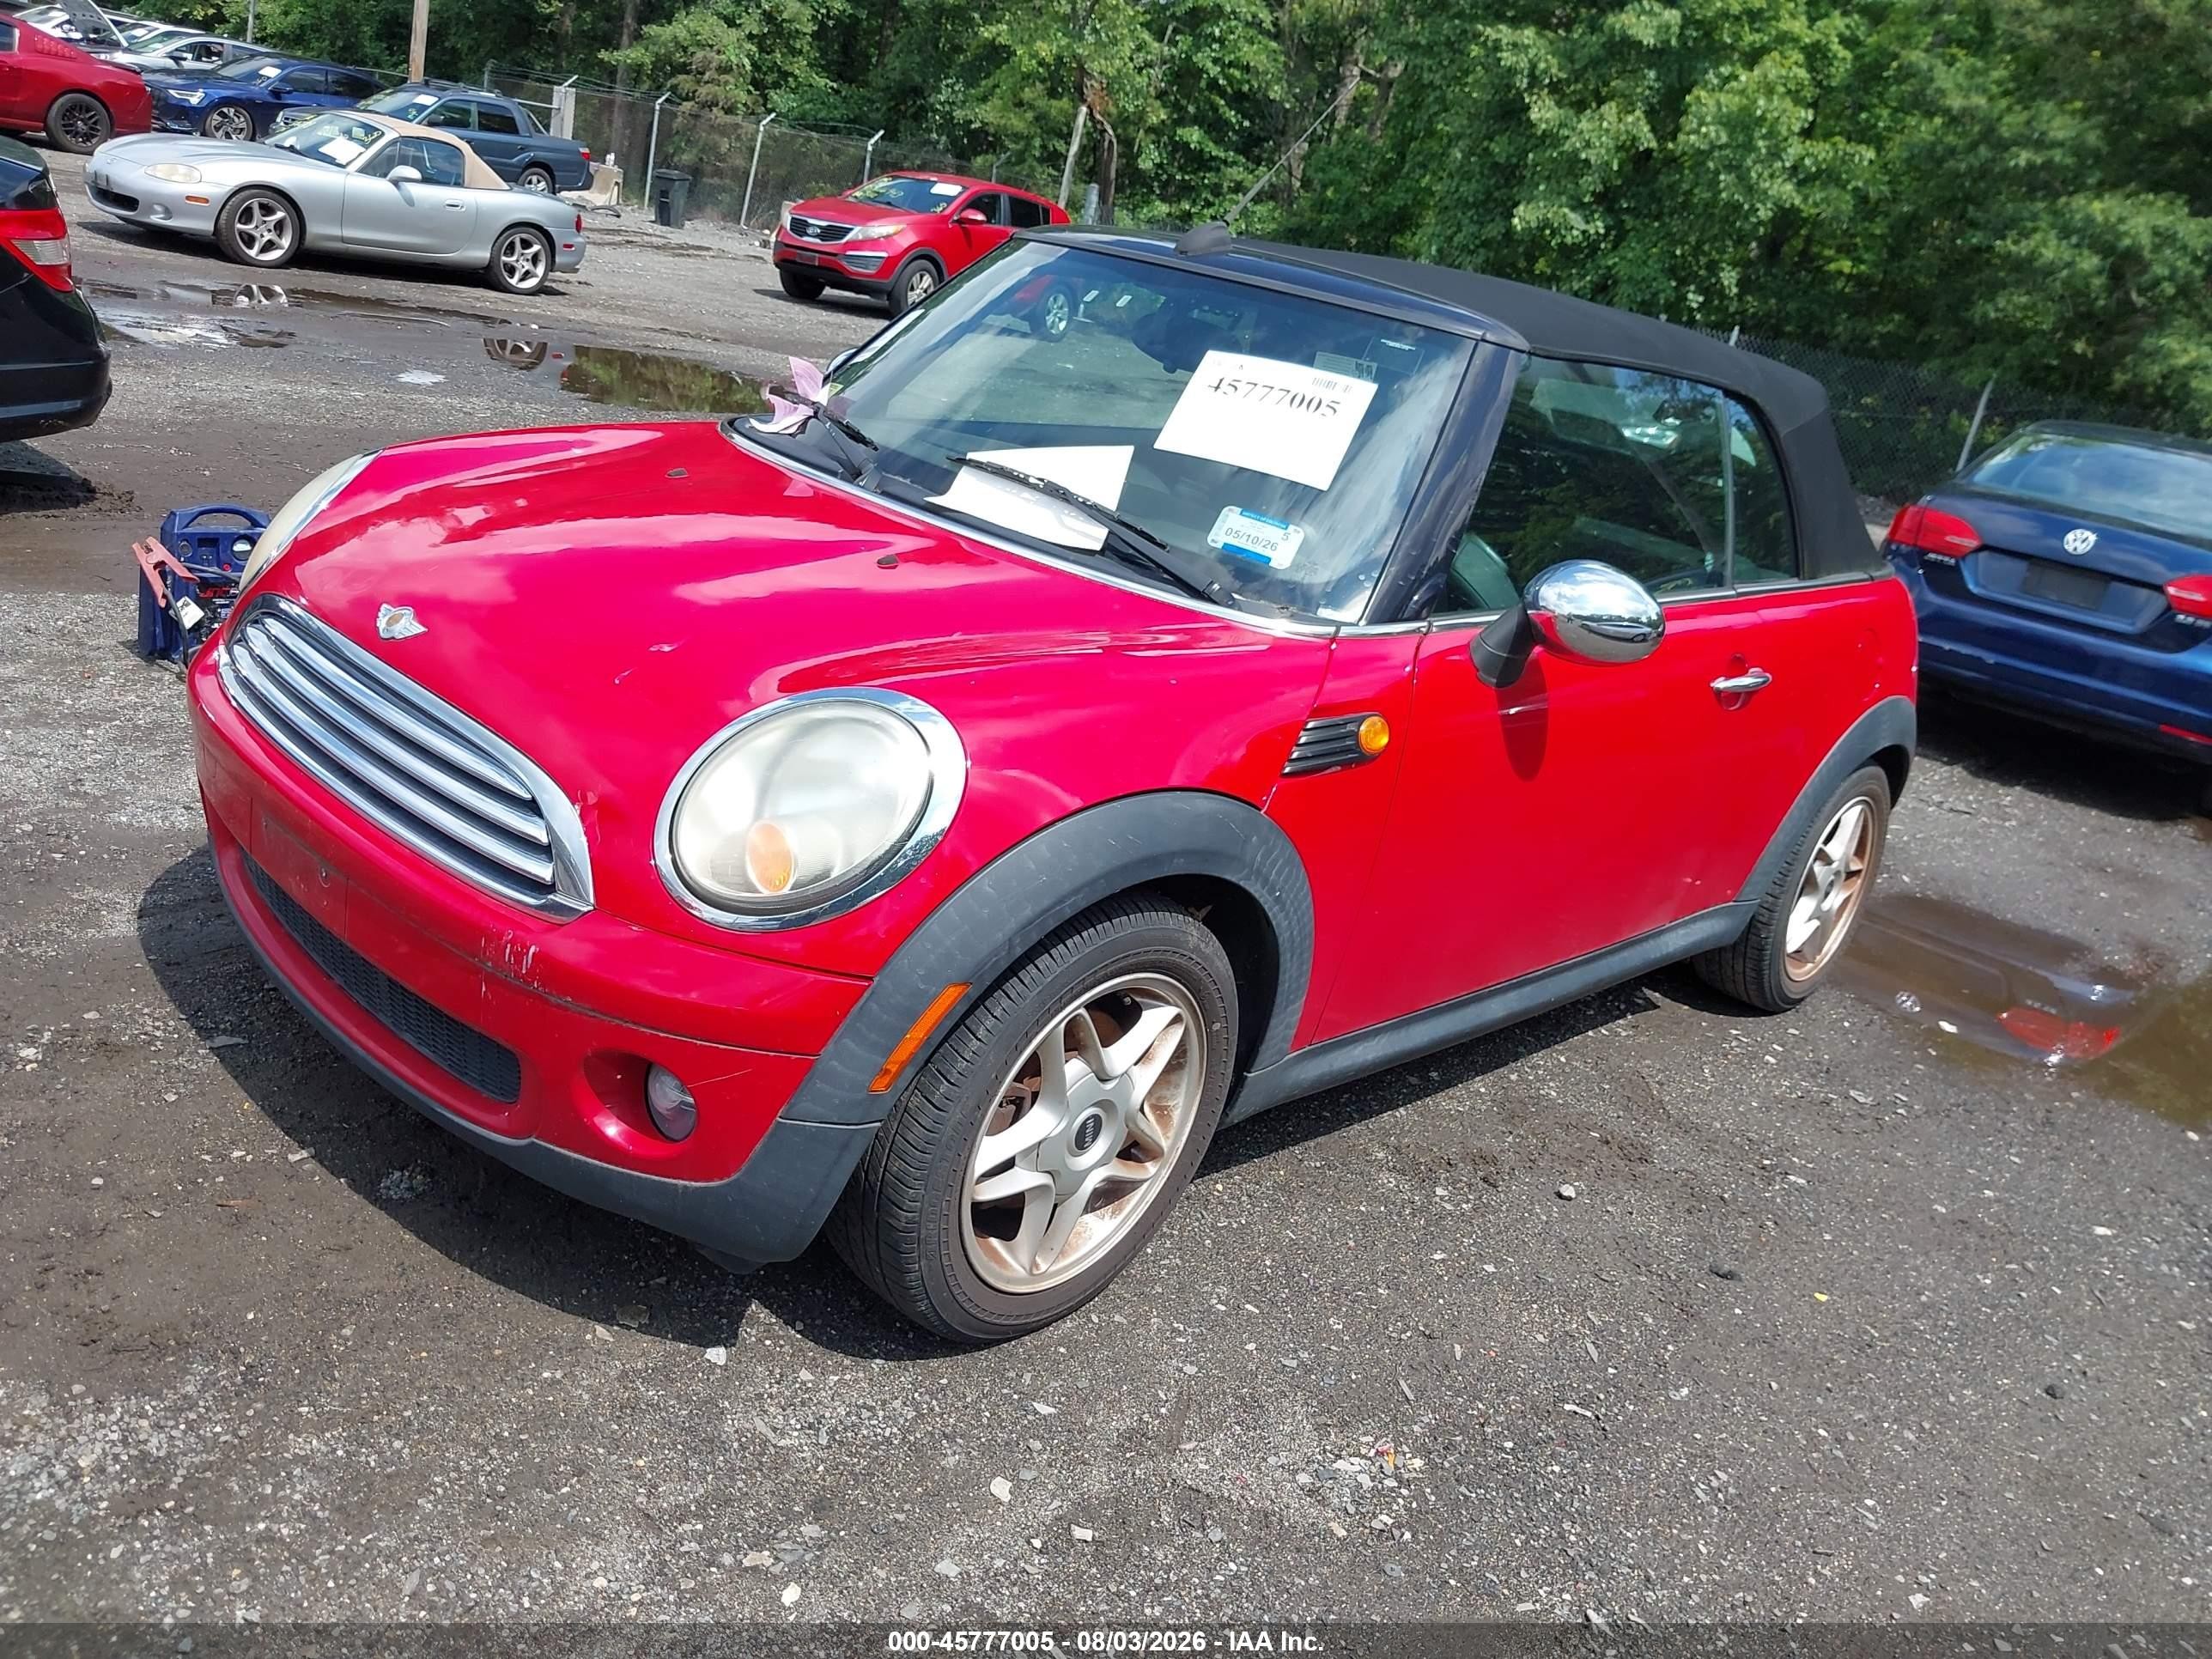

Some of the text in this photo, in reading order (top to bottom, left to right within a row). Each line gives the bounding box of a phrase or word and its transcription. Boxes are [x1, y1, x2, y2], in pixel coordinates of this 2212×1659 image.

[1207, 376, 1341, 417] 45777005
[1224, 527, 1279, 552] 05/10/26
[1084, 1118, 1095, 1148] MINI
